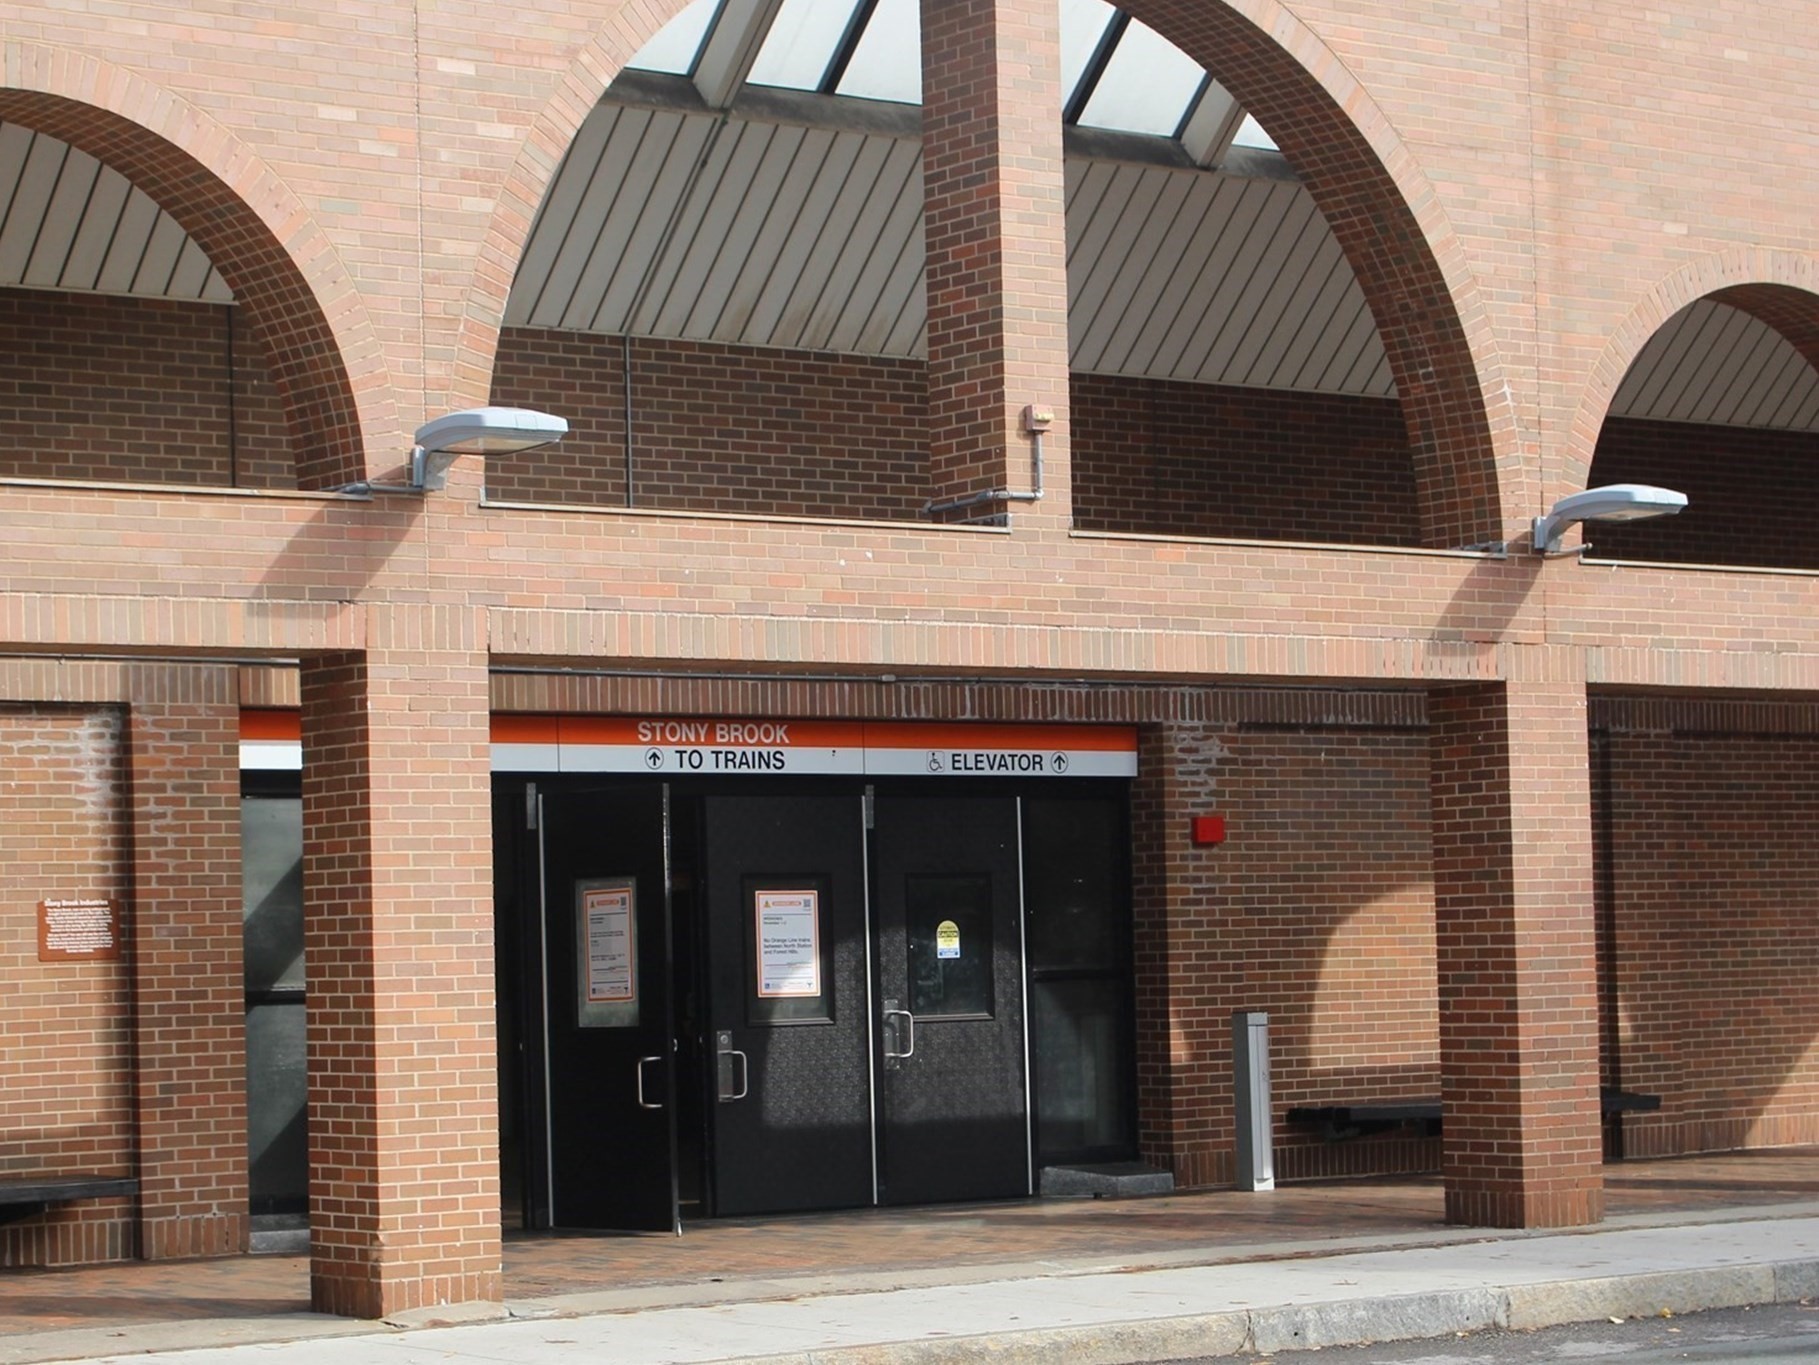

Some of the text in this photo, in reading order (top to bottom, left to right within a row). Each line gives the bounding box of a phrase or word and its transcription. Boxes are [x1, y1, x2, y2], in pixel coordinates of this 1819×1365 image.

[638, 721, 790, 744] STONY BROOK
[675, 750, 785, 770] TO TRAINS
[951, 753, 1043, 771] ELEVATOR
